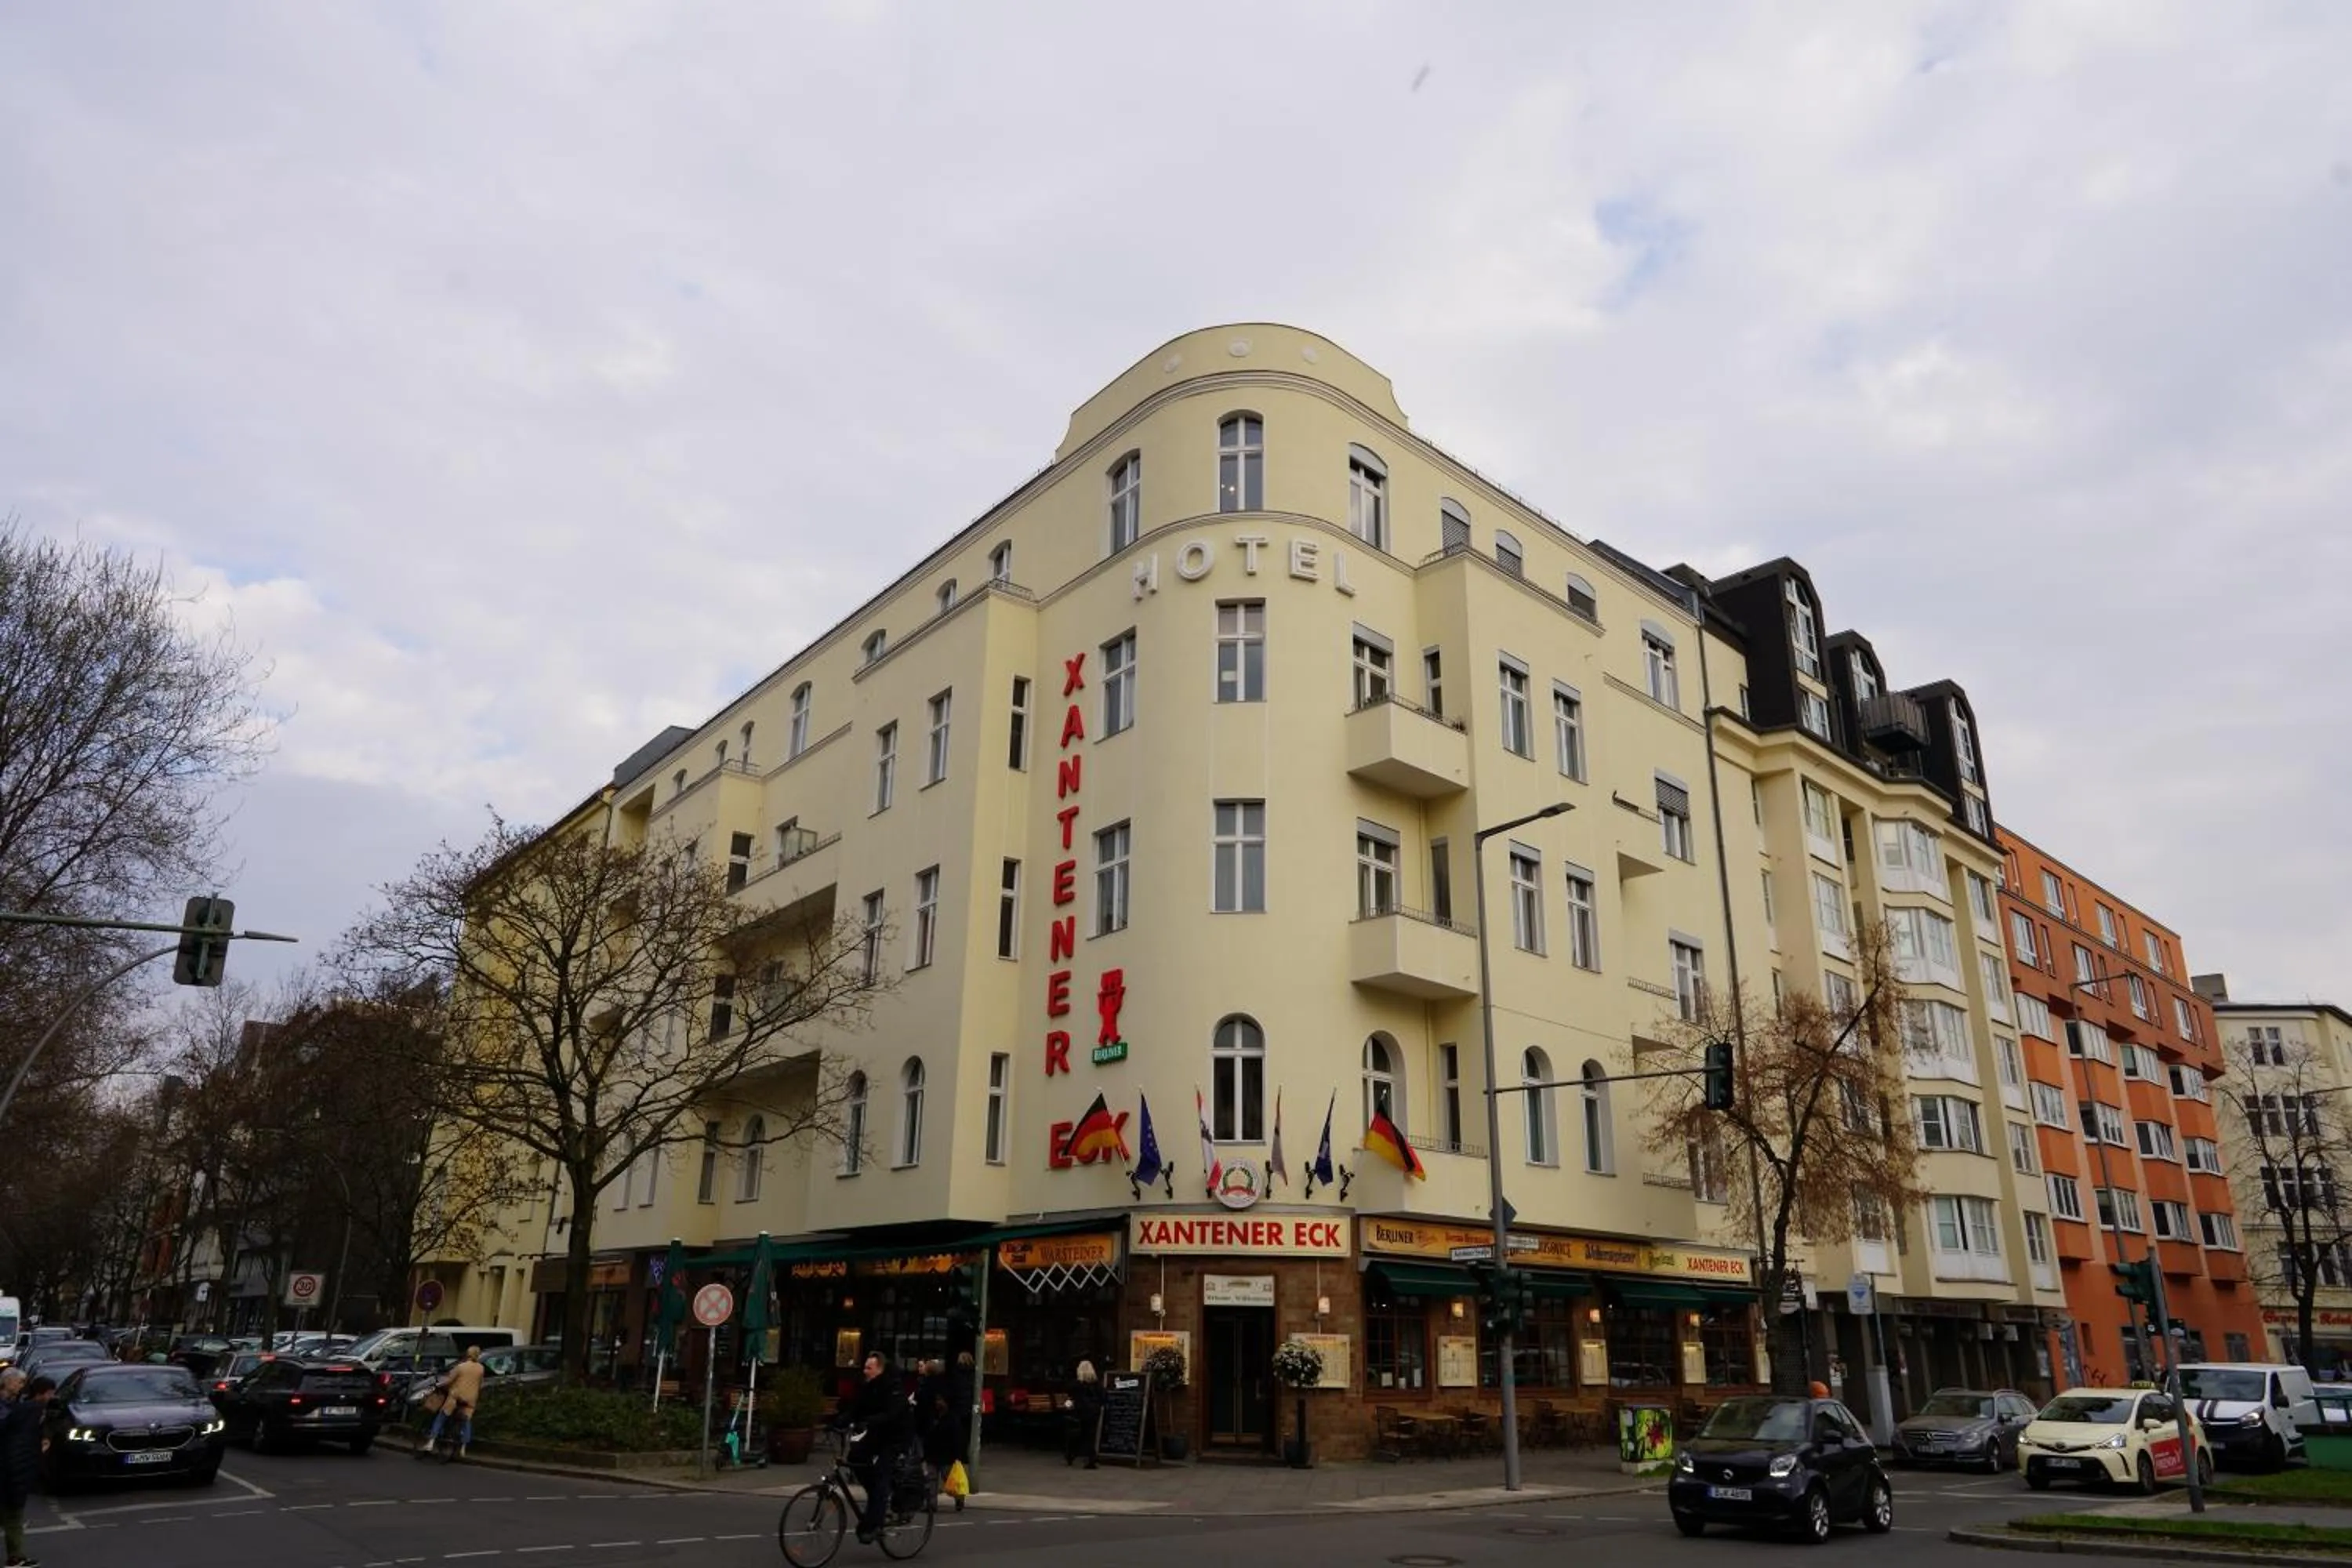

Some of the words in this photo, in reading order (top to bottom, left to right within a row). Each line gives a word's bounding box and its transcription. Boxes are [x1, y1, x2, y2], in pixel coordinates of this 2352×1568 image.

[1131, 533, 1356, 601] HOTEL
[1044, 652, 1086, 1077] XANTENER
[1049, 1111, 1131, 1170] EK
[1138, 1221, 1283, 1247] XANTENER
[1294, 1222, 1341, 1247] ECK
[1376, 1224, 1414, 1244] BERLINER
[1039, 1245, 1104, 1263] WARSTEINER
[1687, 1257, 1728, 1272] XANTENER
[1731, 1261, 1744, 1274] ECK
